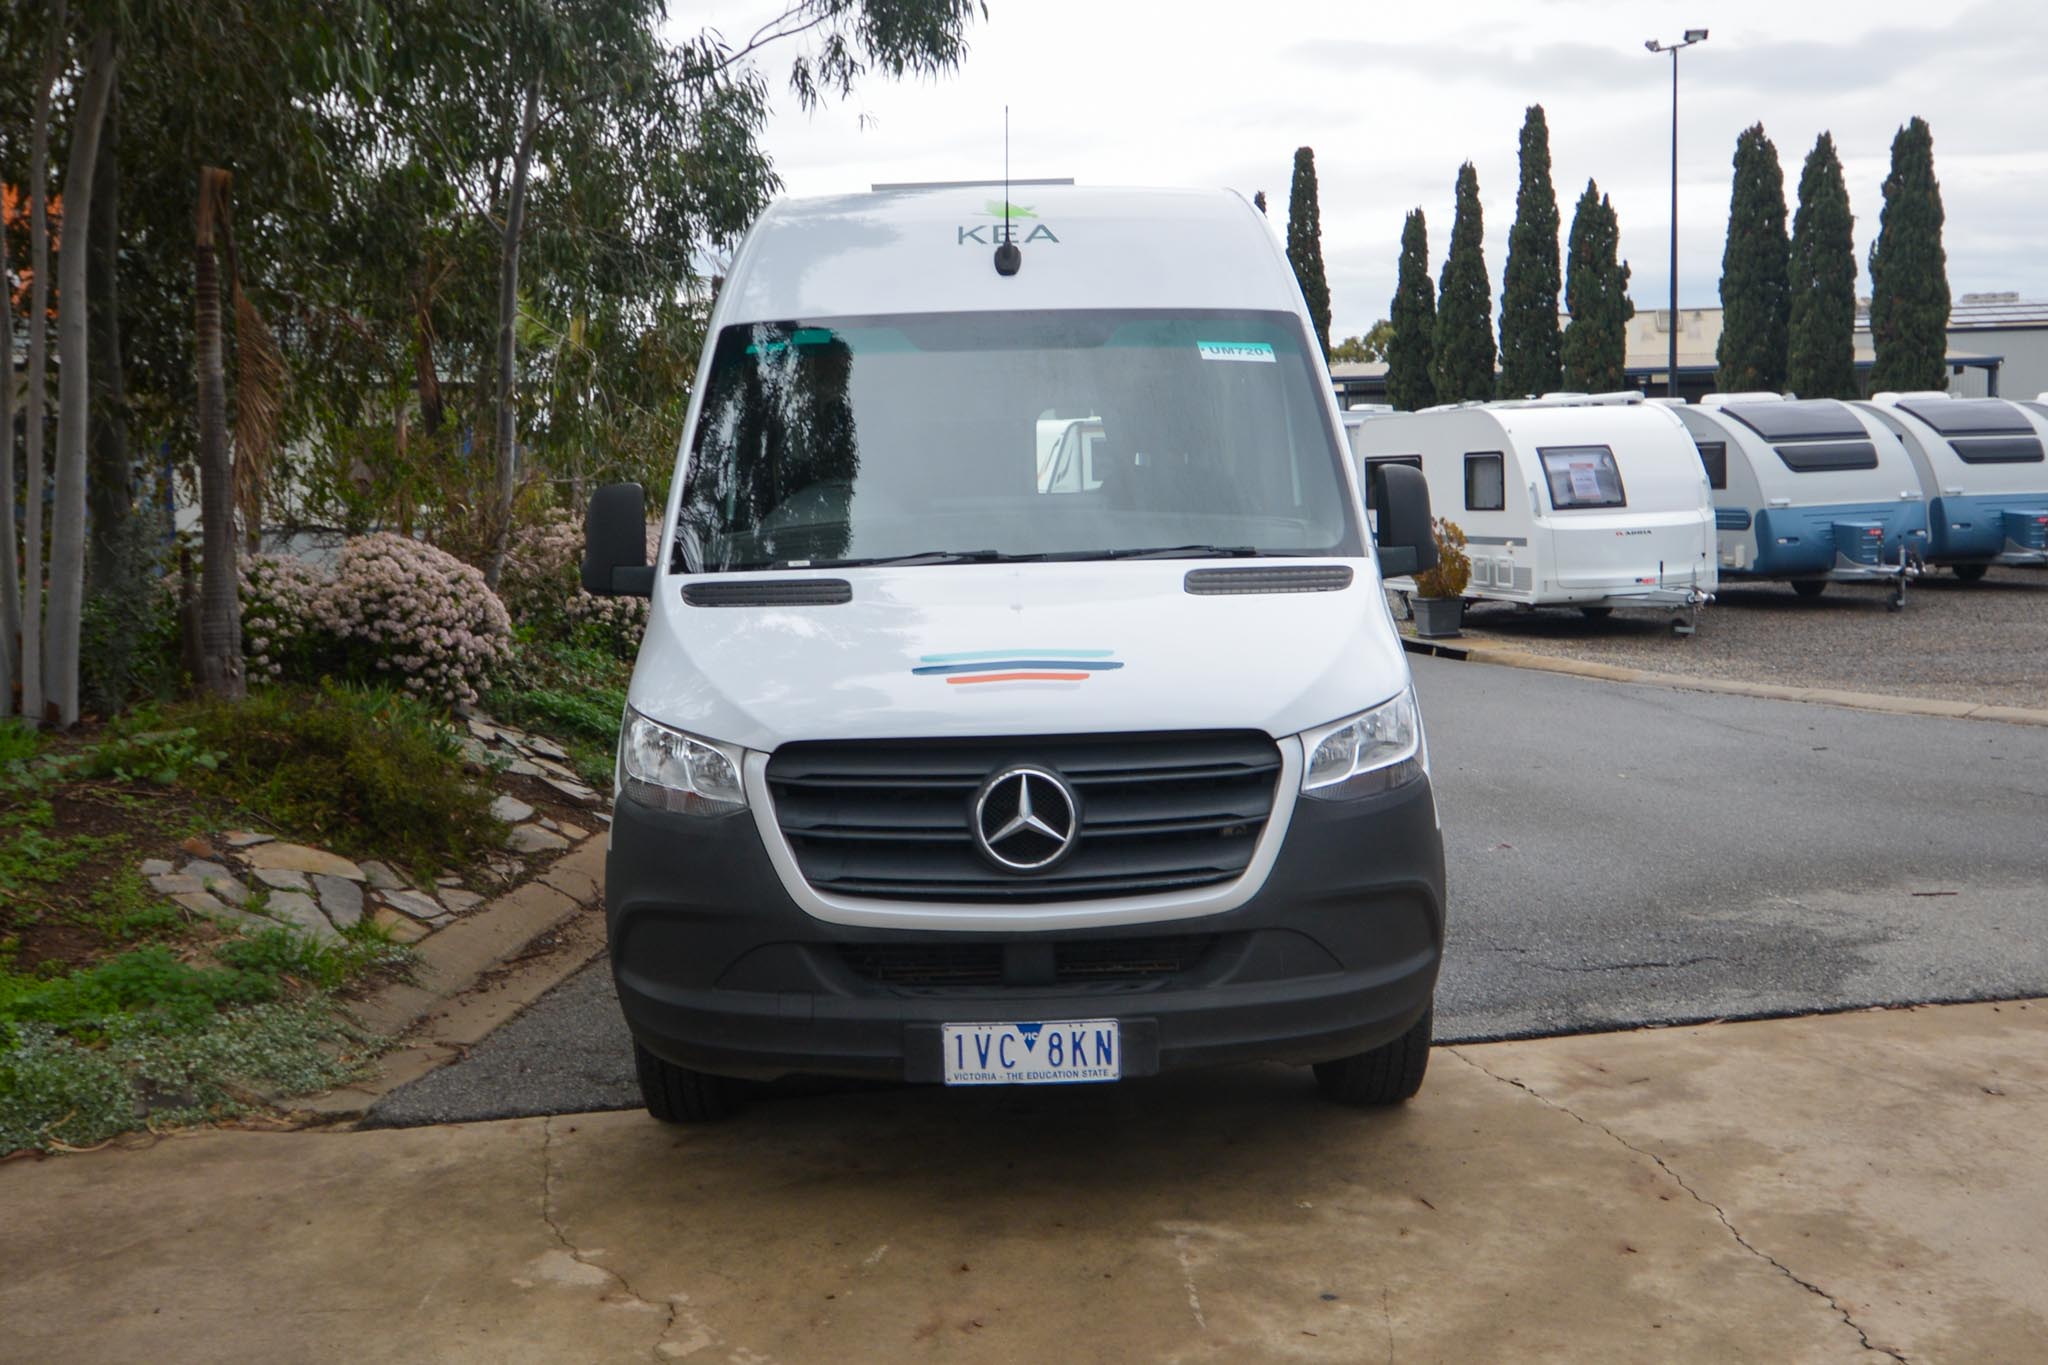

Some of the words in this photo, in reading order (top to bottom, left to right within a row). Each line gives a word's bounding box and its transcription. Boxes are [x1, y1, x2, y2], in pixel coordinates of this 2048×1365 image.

[958, 224, 1060, 245] KEA
[1022, 1032, 1039, 1041] VIC
[955, 1033, 1016, 1070] 1VC
[1048, 1030, 1112, 1067] 8KN
[953, 1073, 996, 1081] VICTORIA
[1006, 1072, 1024, 1080] THE
[1026, 1070, 1079, 1079] EDUCATION
[1081, 1069, 1109, 1078] STATE
